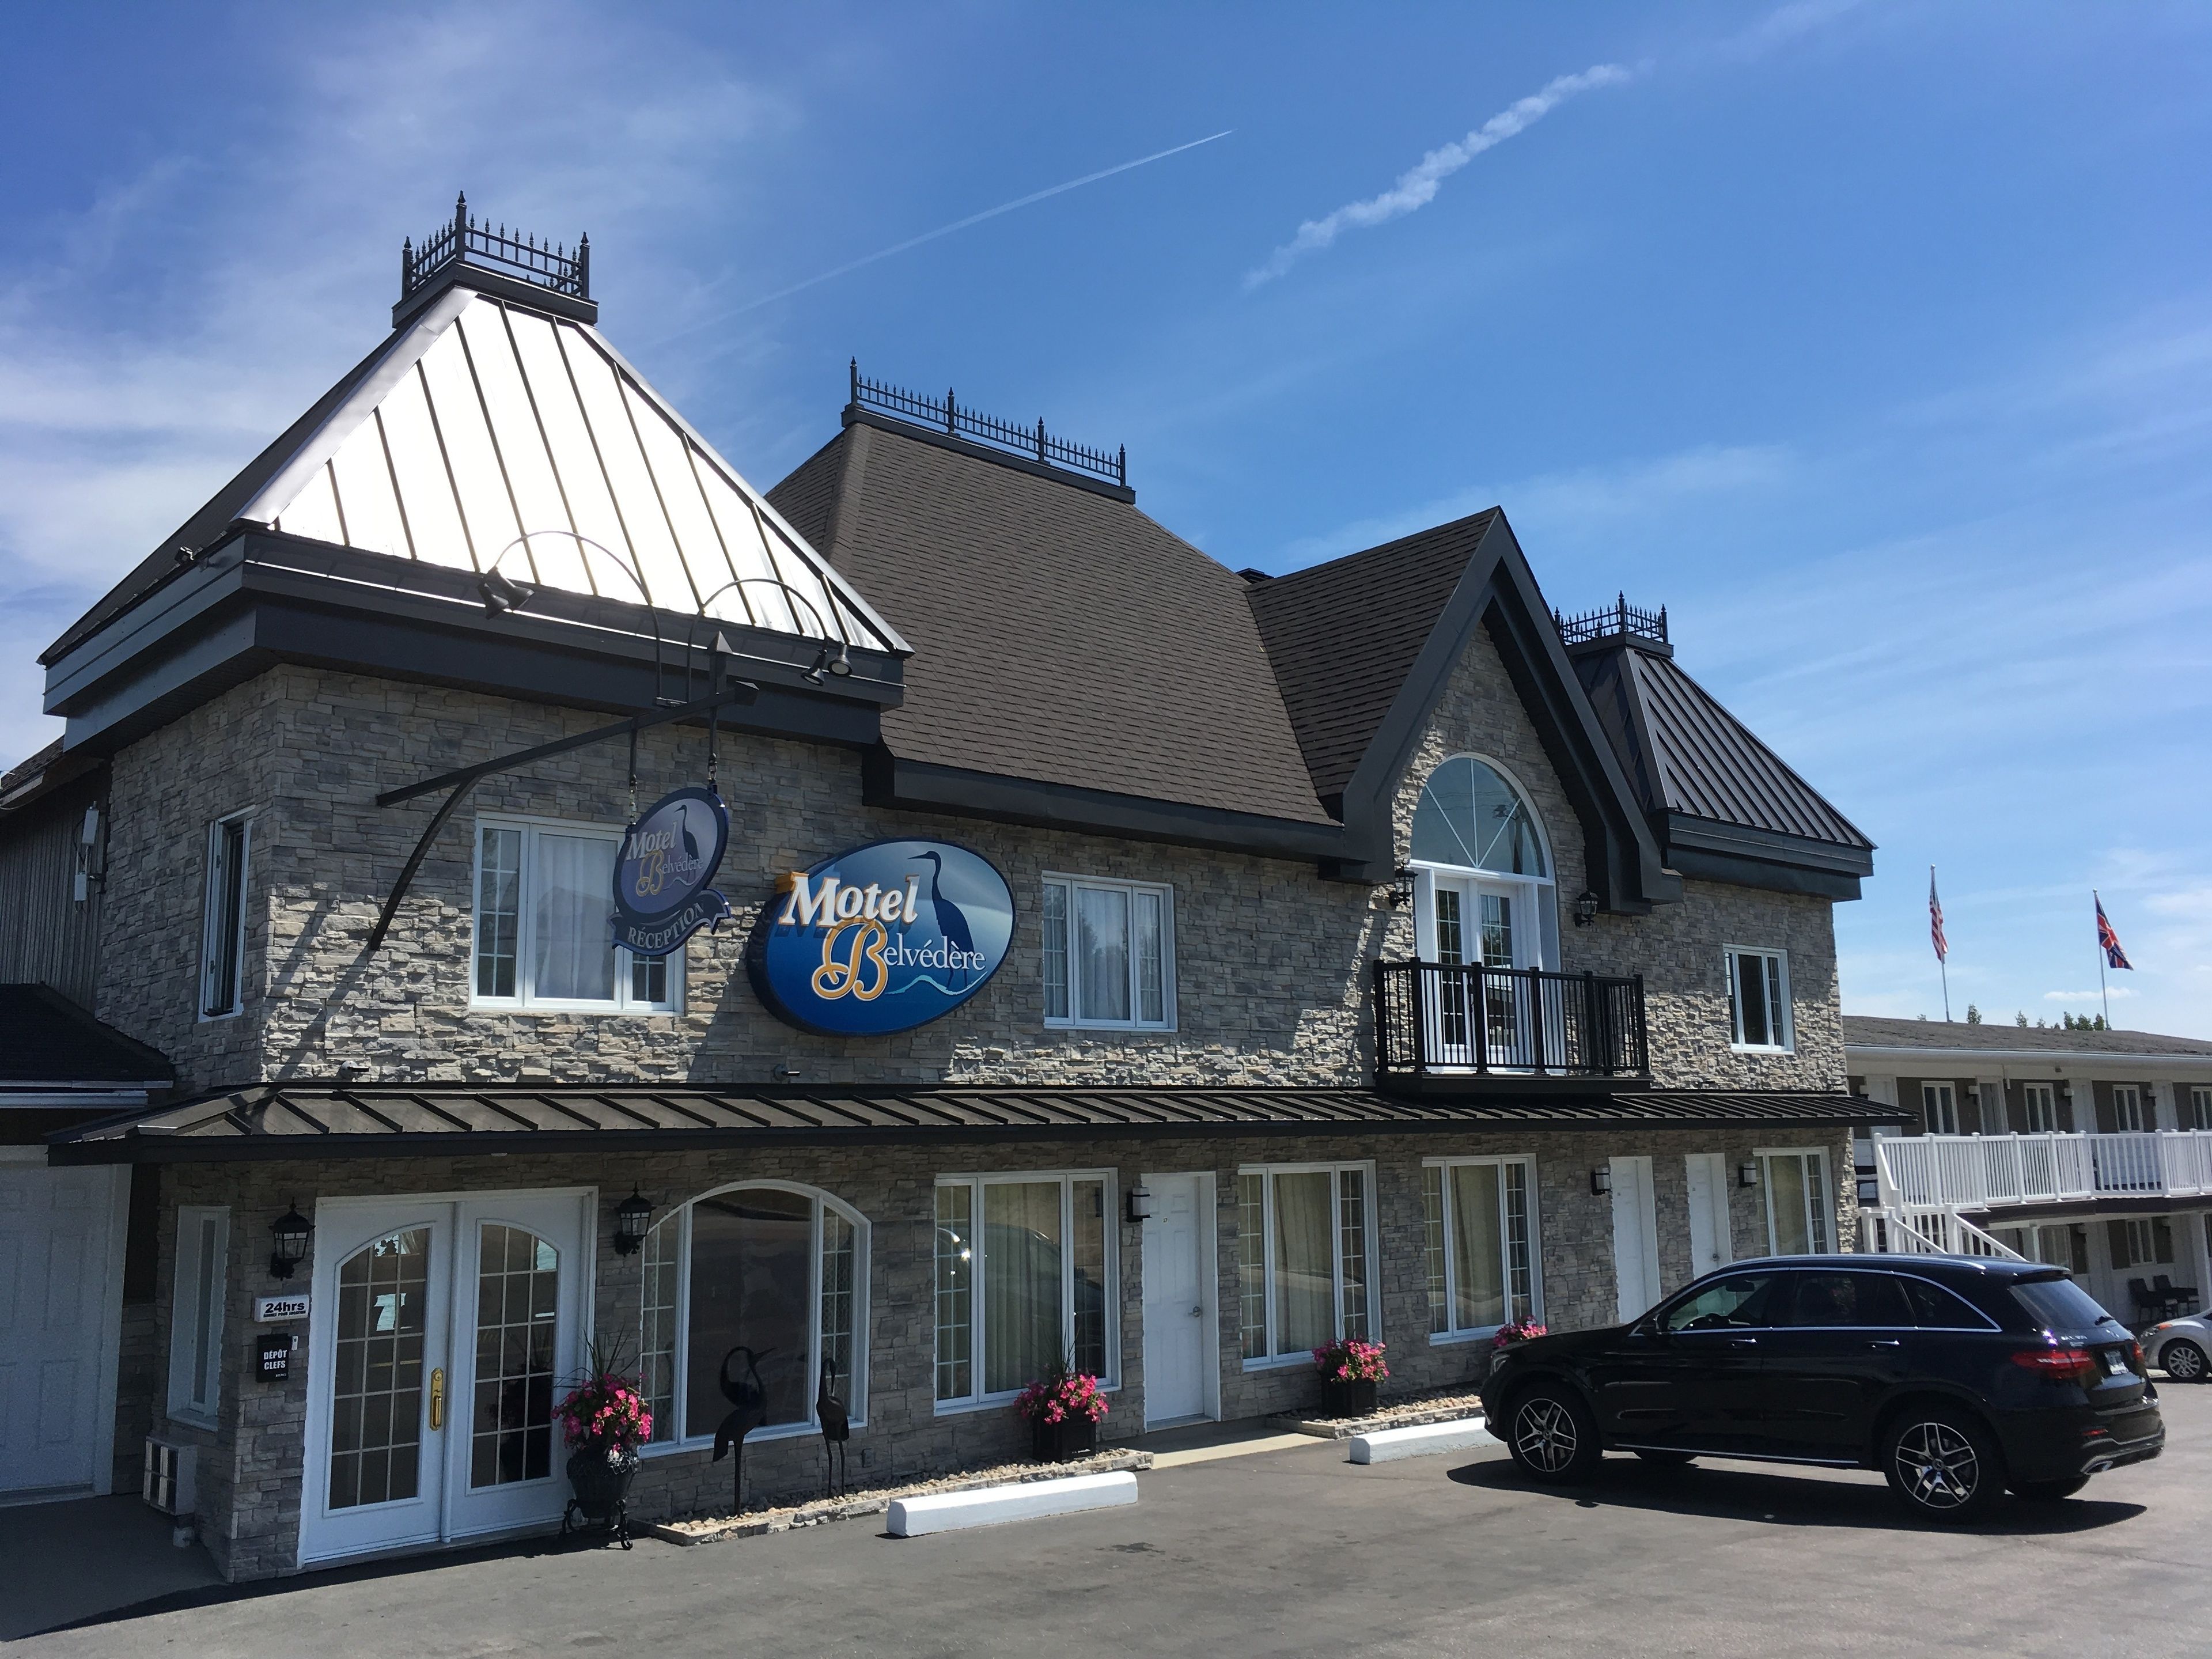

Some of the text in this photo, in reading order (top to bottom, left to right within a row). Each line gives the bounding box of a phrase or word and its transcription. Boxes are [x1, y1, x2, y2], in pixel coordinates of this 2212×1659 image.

[626, 820, 677, 861] Motel
[636, 849, 703, 897] Belvédère
[778, 871, 921, 927] Motel
[627, 901, 704, 949] RÉCEPTION
[811, 915, 987, 1001] Belvédère
[265, 1302, 305, 1313] 24hrs
[263, 1349, 287, 1360] DÉPÔT
[264, 1360, 286, 1370] CLEFS
